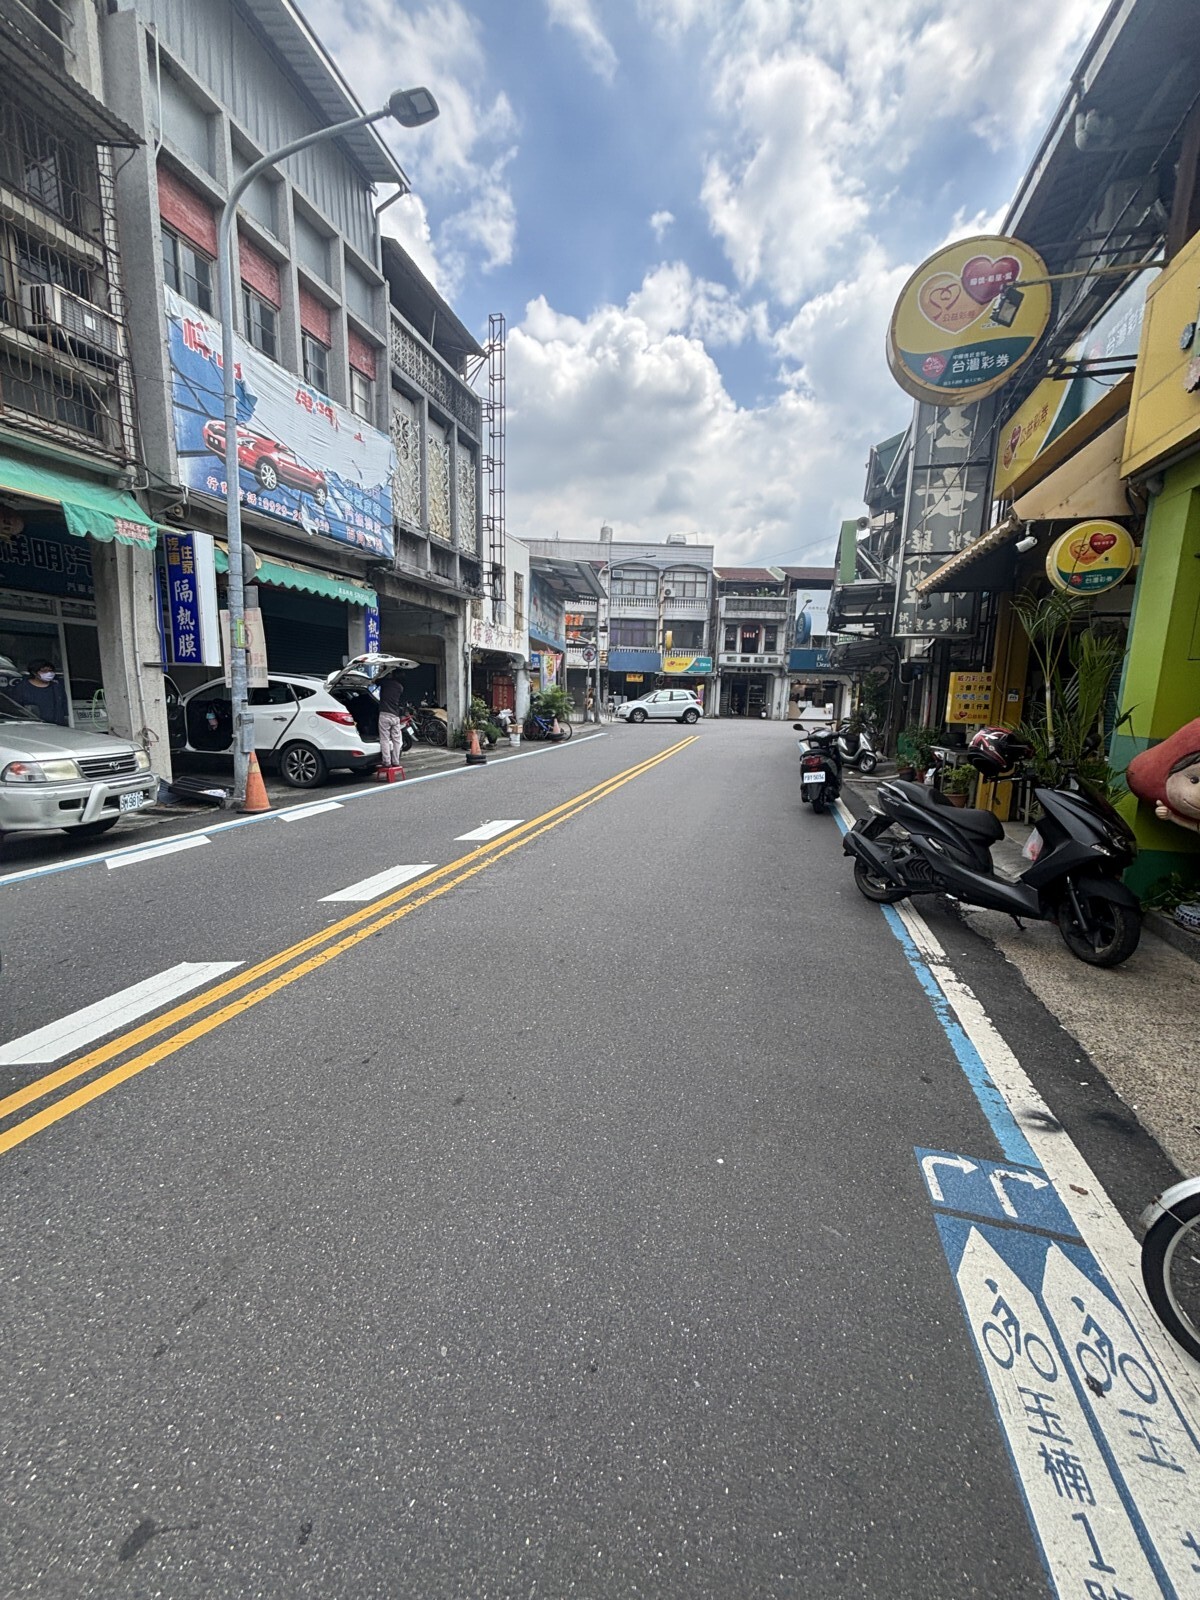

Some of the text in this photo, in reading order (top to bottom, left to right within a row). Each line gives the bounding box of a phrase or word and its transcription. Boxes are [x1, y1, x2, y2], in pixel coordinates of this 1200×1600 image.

[952, 353, 1010, 374] 台灣彩券
[180, 545, 194, 575] 住家
[173, 578, 197, 658] 隔熱膜
